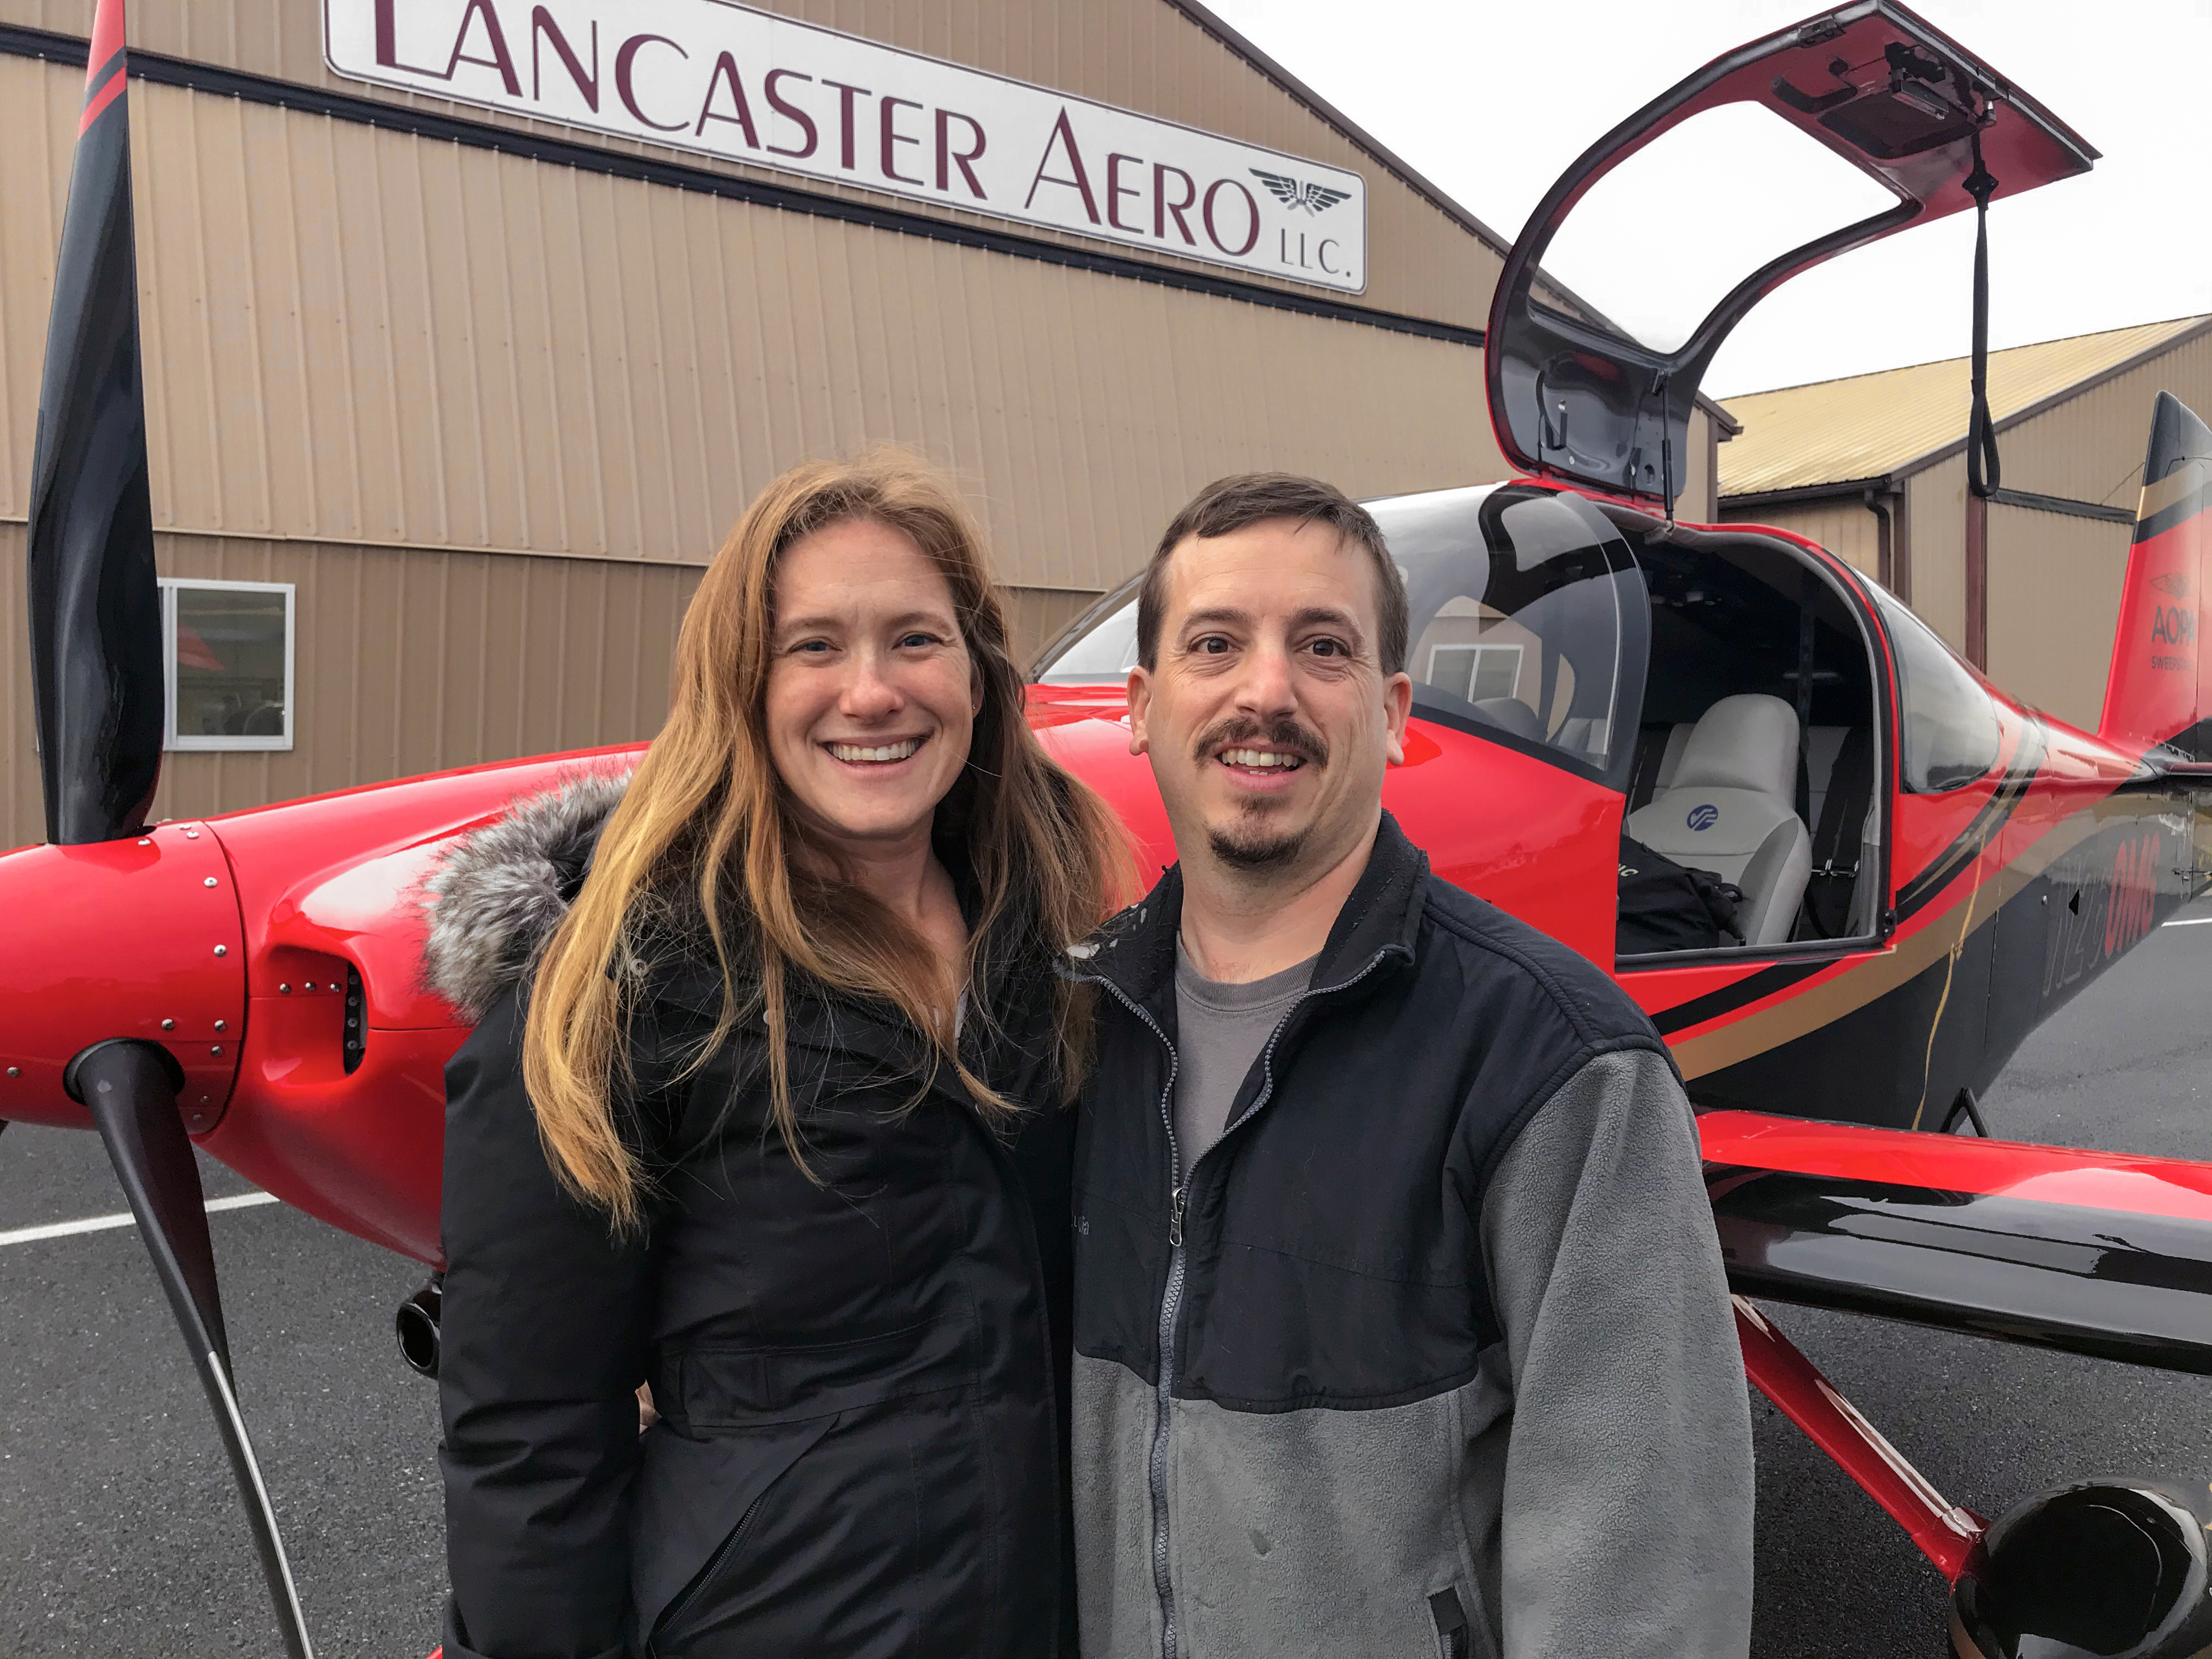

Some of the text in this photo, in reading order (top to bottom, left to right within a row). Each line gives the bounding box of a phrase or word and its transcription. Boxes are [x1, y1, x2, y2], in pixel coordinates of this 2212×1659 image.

[375, 0, 1260, 256] LANCASTER AERO
[1281, 228, 1351, 278] LLC.
[2151, 605, 2195, 645] AOPA
